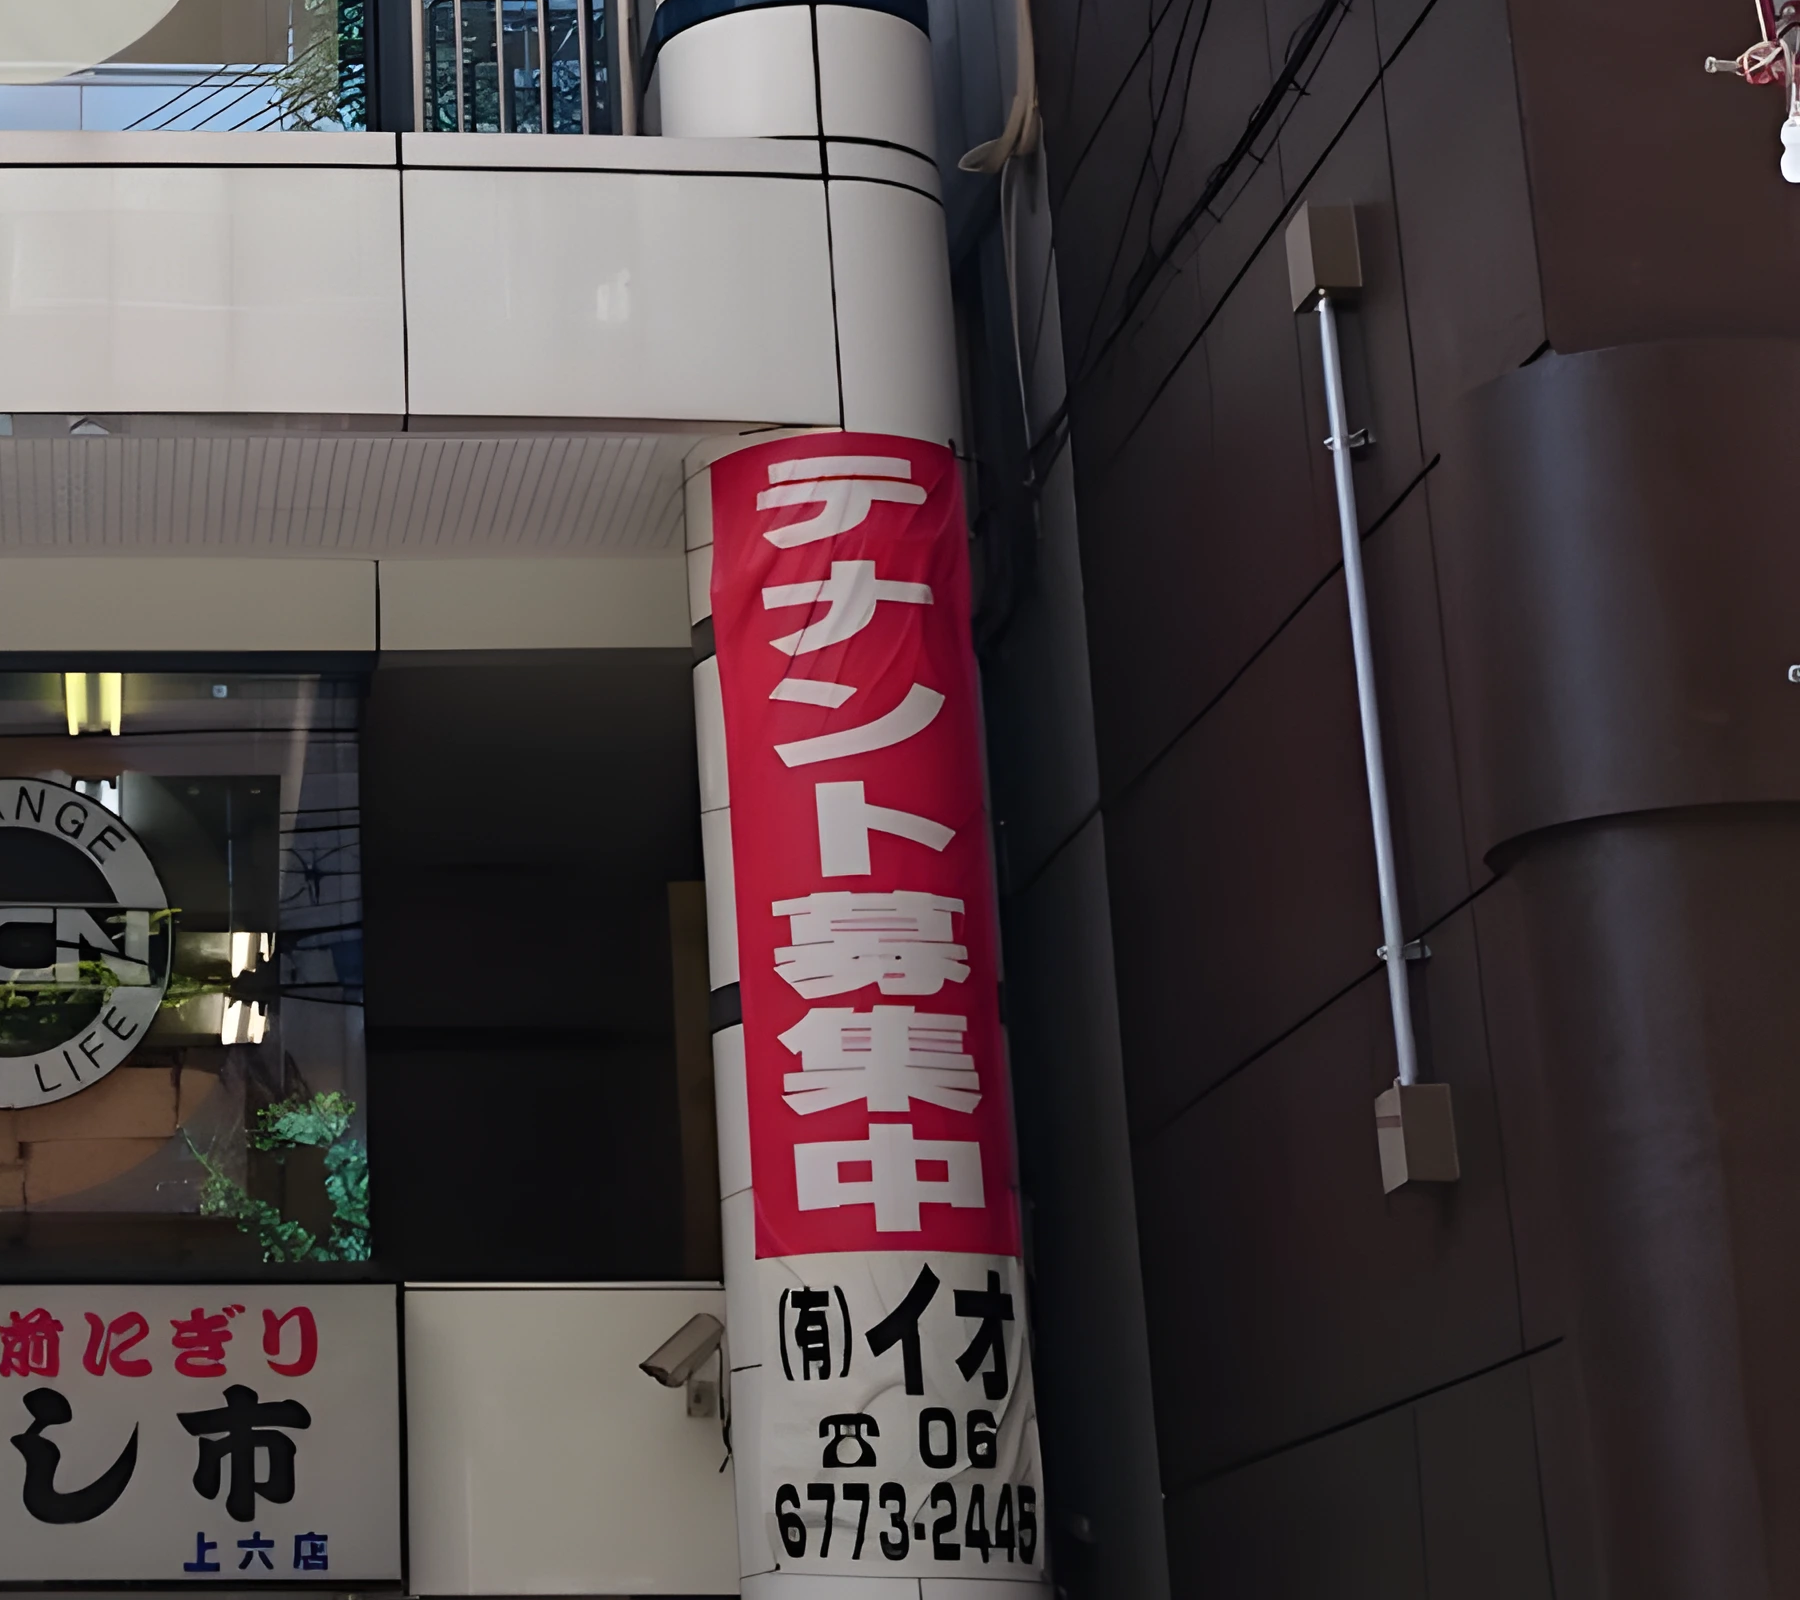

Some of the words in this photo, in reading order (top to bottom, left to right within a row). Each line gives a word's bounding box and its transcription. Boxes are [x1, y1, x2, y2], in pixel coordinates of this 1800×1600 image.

[755, 455, 987, 1233] テナント募集中
[32, 1003, 141, 1095] LIFE
[919, 1406, 997, 1470] 06
[182, 1530, 330, 1573] 上六店
